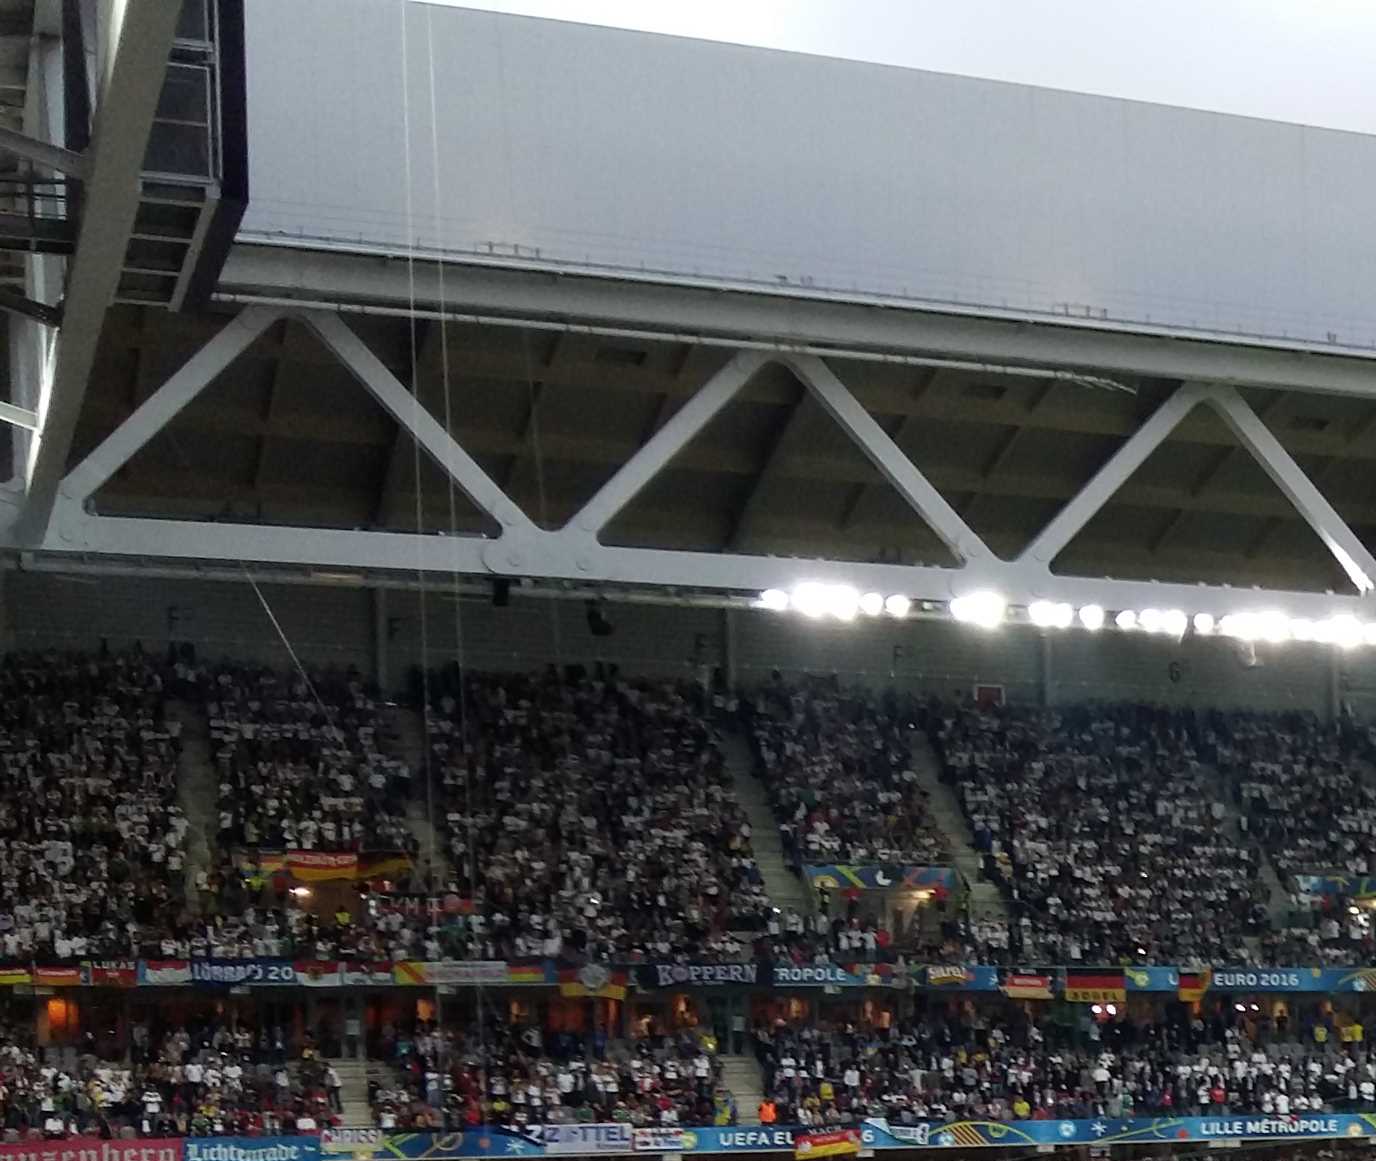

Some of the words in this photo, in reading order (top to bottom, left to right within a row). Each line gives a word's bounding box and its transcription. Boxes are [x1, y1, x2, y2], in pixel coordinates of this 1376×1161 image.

[1214, 970, 1257, 986] EURO
[1260, 970, 1298, 986] 2016
[1201, 1121, 1243, 1135] LILLE
[1246, 1118, 1337, 1134] MÉTROPOLE
[719, 1131, 770, 1147] UEFA
